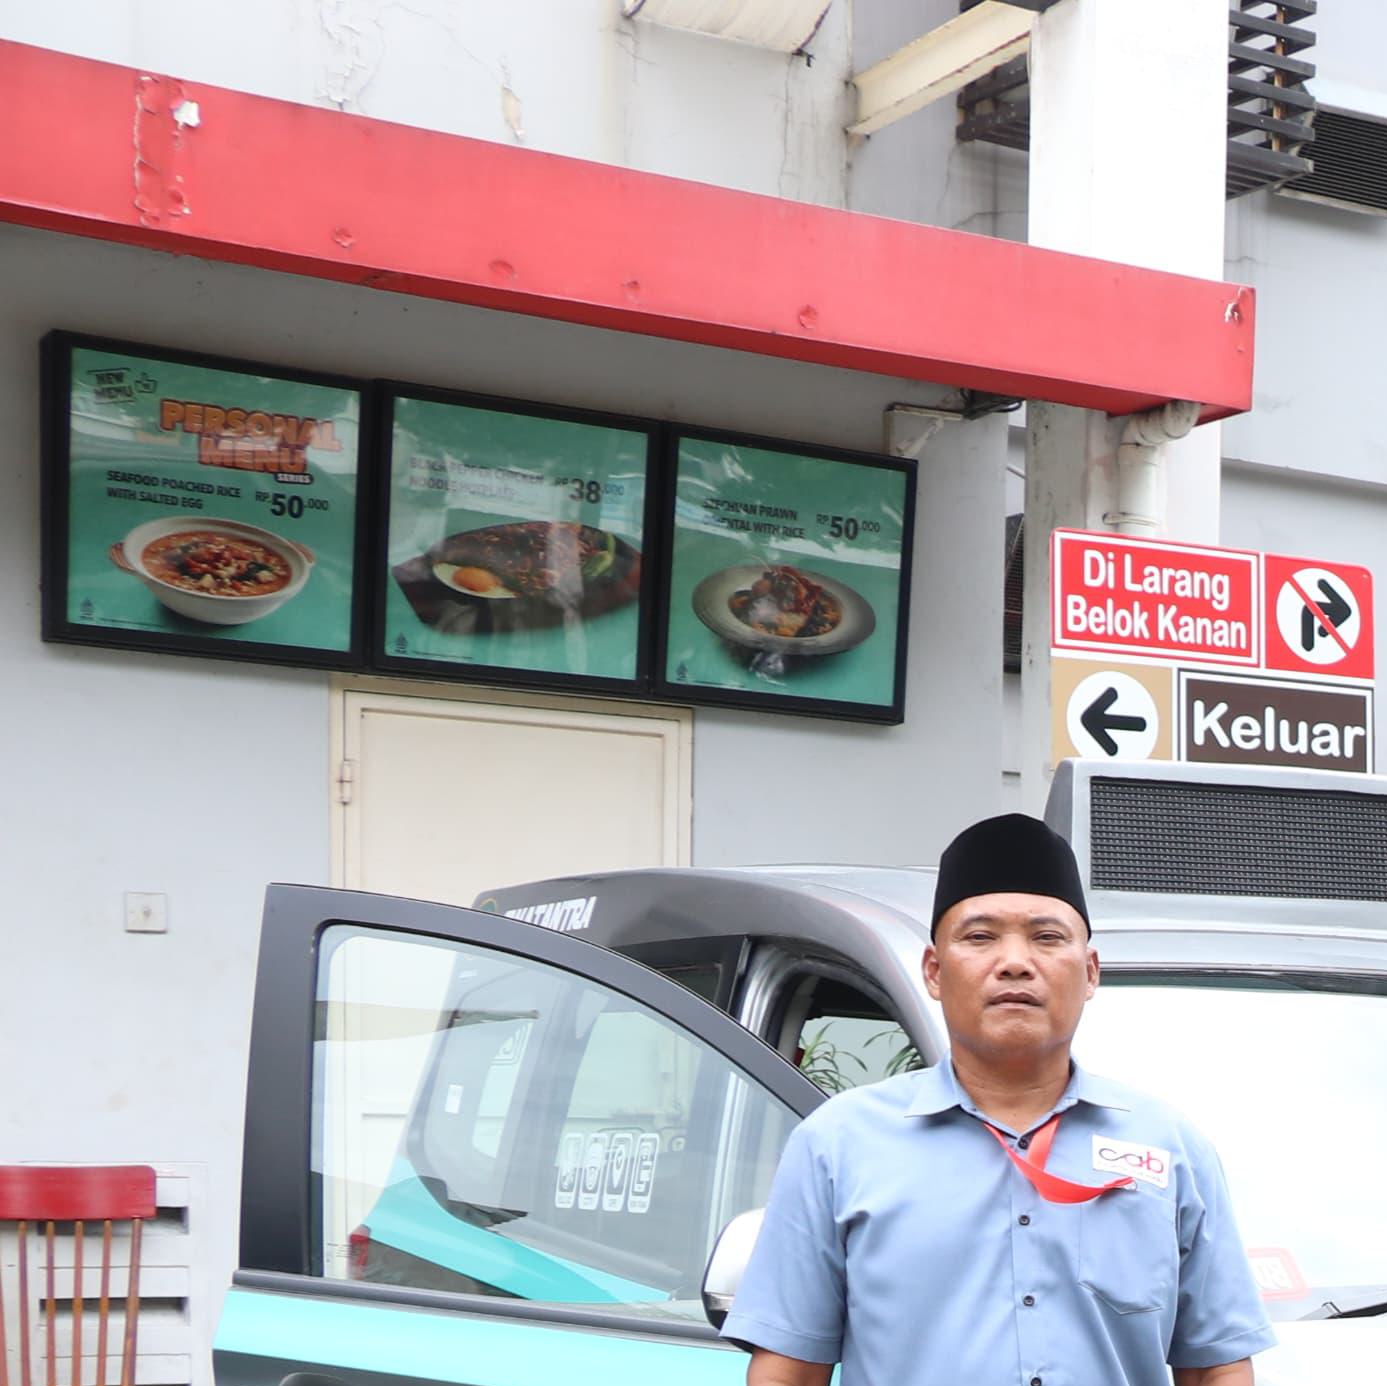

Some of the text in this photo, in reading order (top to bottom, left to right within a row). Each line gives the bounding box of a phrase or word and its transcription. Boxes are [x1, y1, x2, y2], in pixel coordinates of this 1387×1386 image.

[159, 398, 343, 452] PERSONAL
[198, 433, 308, 474] MENU
[107, 470, 241, 498] SEAFOOD POACHED RICE
[107, 487, 204, 510] WITH SALTED EGG
[759, 503, 798, 521] PRAWN
[753, 521, 780, 537] WITH
[782, 526, 806, 539] RICE
[1083, 549, 1231, 611] Di Larang
[1066, 594, 1248, 650] Belok Kanan
[1193, 699, 1367, 759] Keluar
[1098, 1147, 1165, 1174] cab
